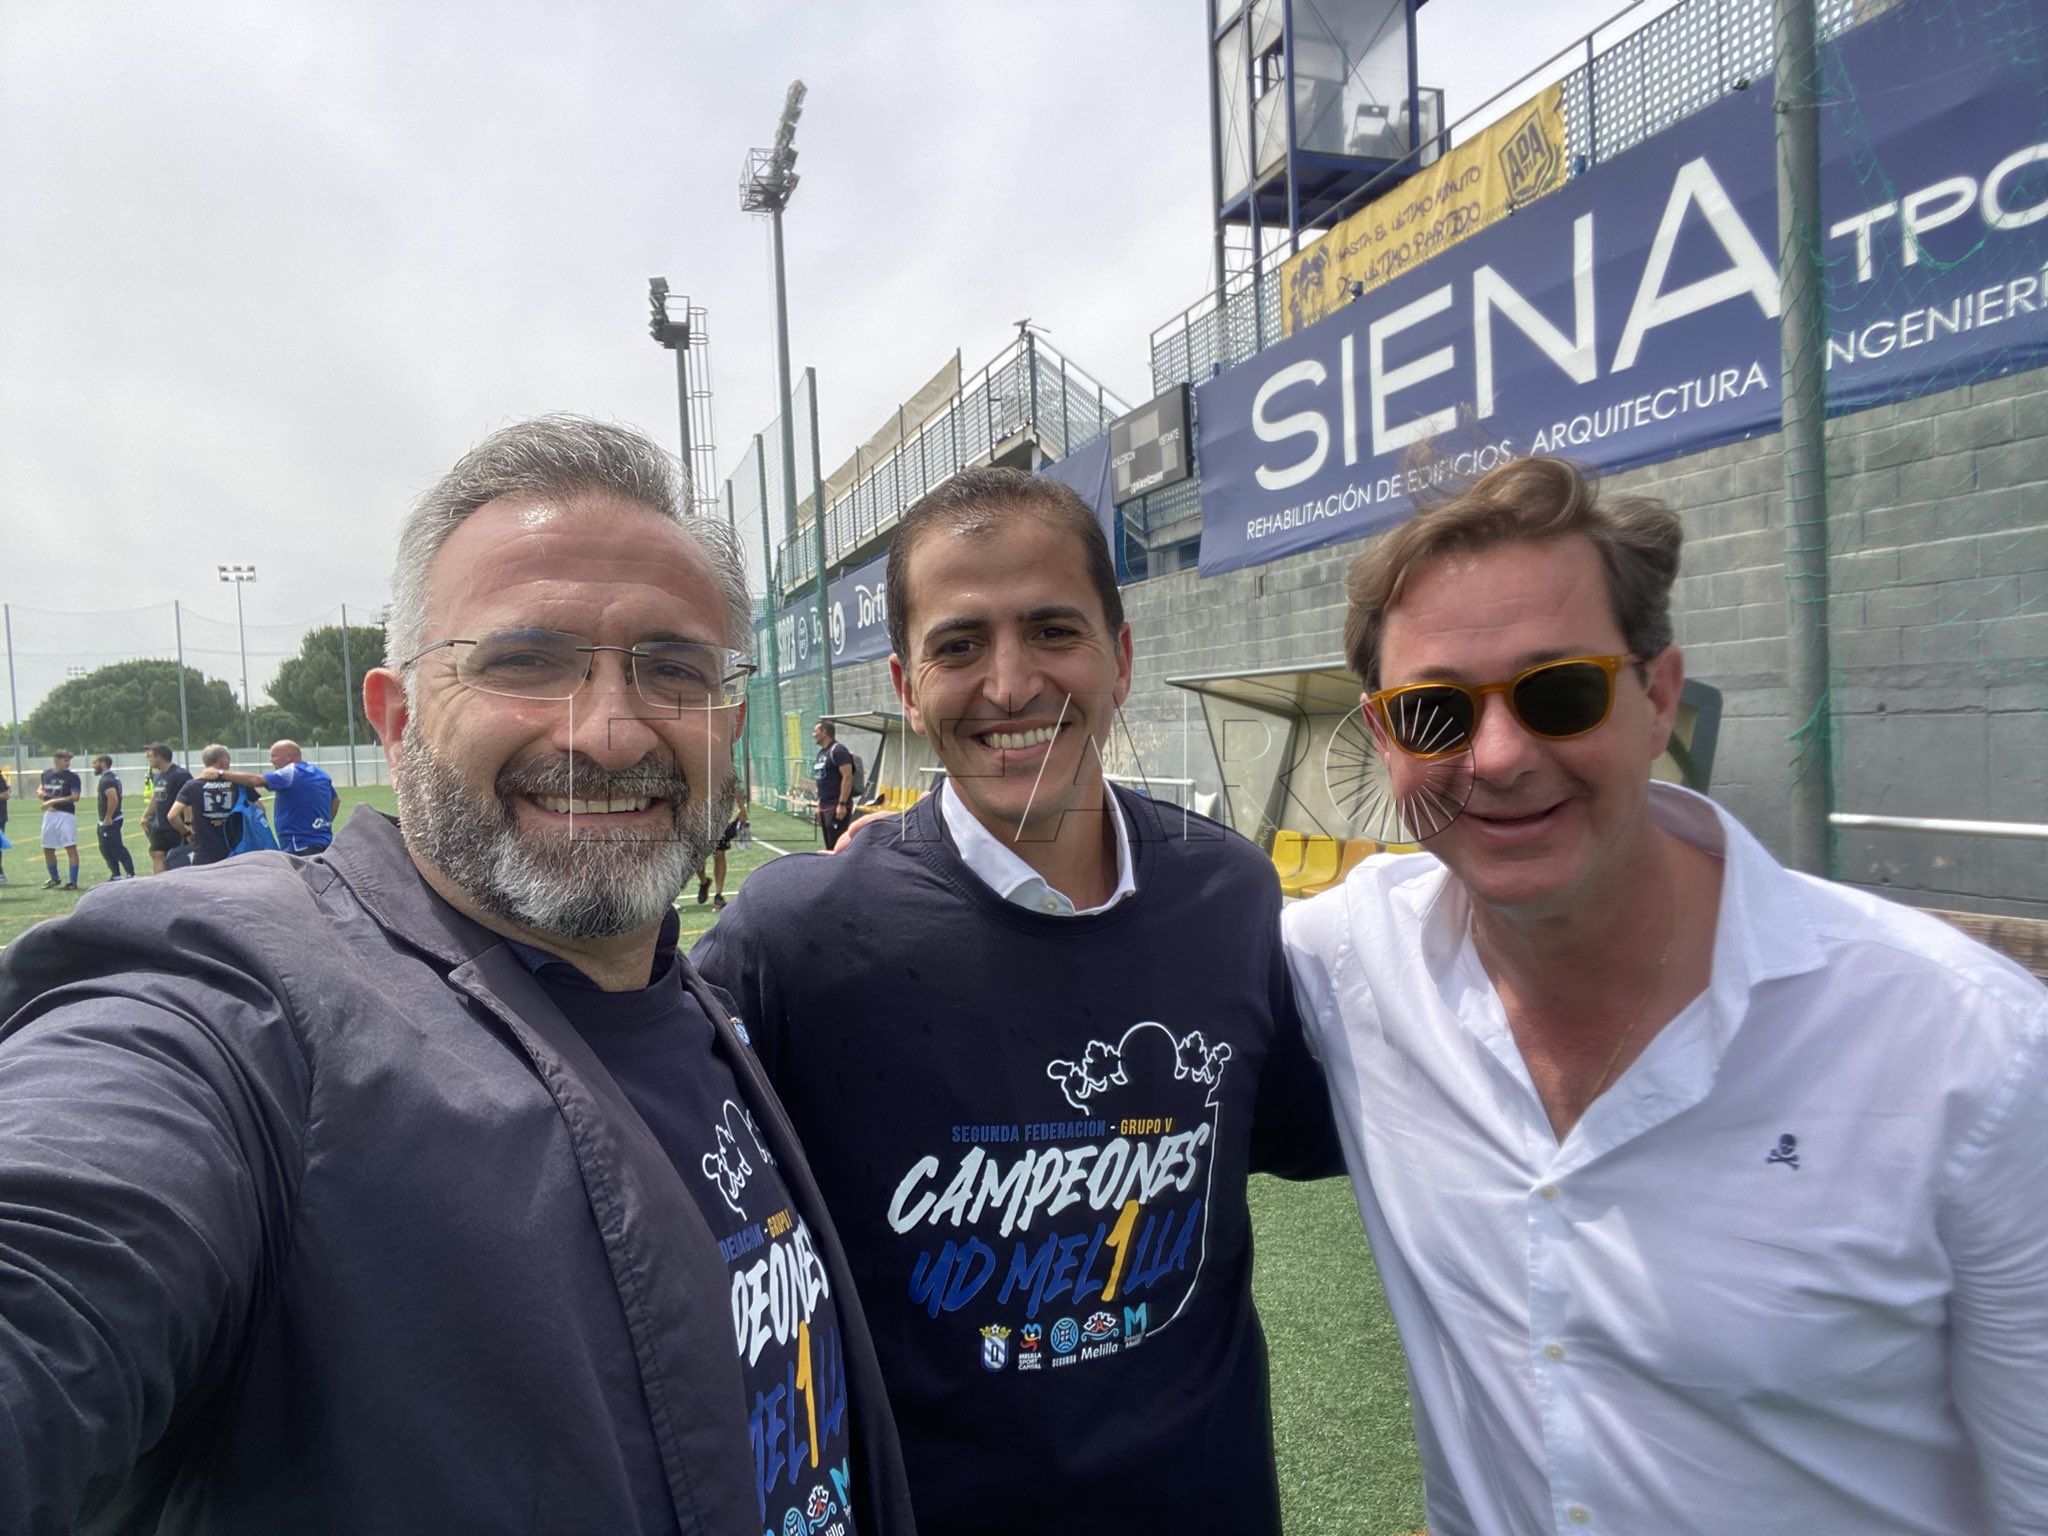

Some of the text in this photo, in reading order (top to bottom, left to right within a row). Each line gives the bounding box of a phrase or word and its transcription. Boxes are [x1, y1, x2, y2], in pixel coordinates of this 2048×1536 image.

[1337, 230, 1373, 263] HASTA
[1253, 154, 1783, 492] SIENA
[1246, 484, 1372, 541] REHABILITACIÓN
[1375, 473, 1401, 500] DE
[1530, 361, 1770, 456] ARQUITECTURA
[951, 1124, 1020, 1143] SEGUNDA
[1023, 1119, 1106, 1141] FEDERACION
[1120, 1118, 1162, 1136] GRUPO
[1162, 1117, 1174, 1133] V
[886, 1122, 1210, 1238] CAMPEONES
[908, 1235, 997, 1320] UD
[1018, 1363, 1042, 1371] CAPITAL
[1080, 1342, 1119, 1361] Melilla
